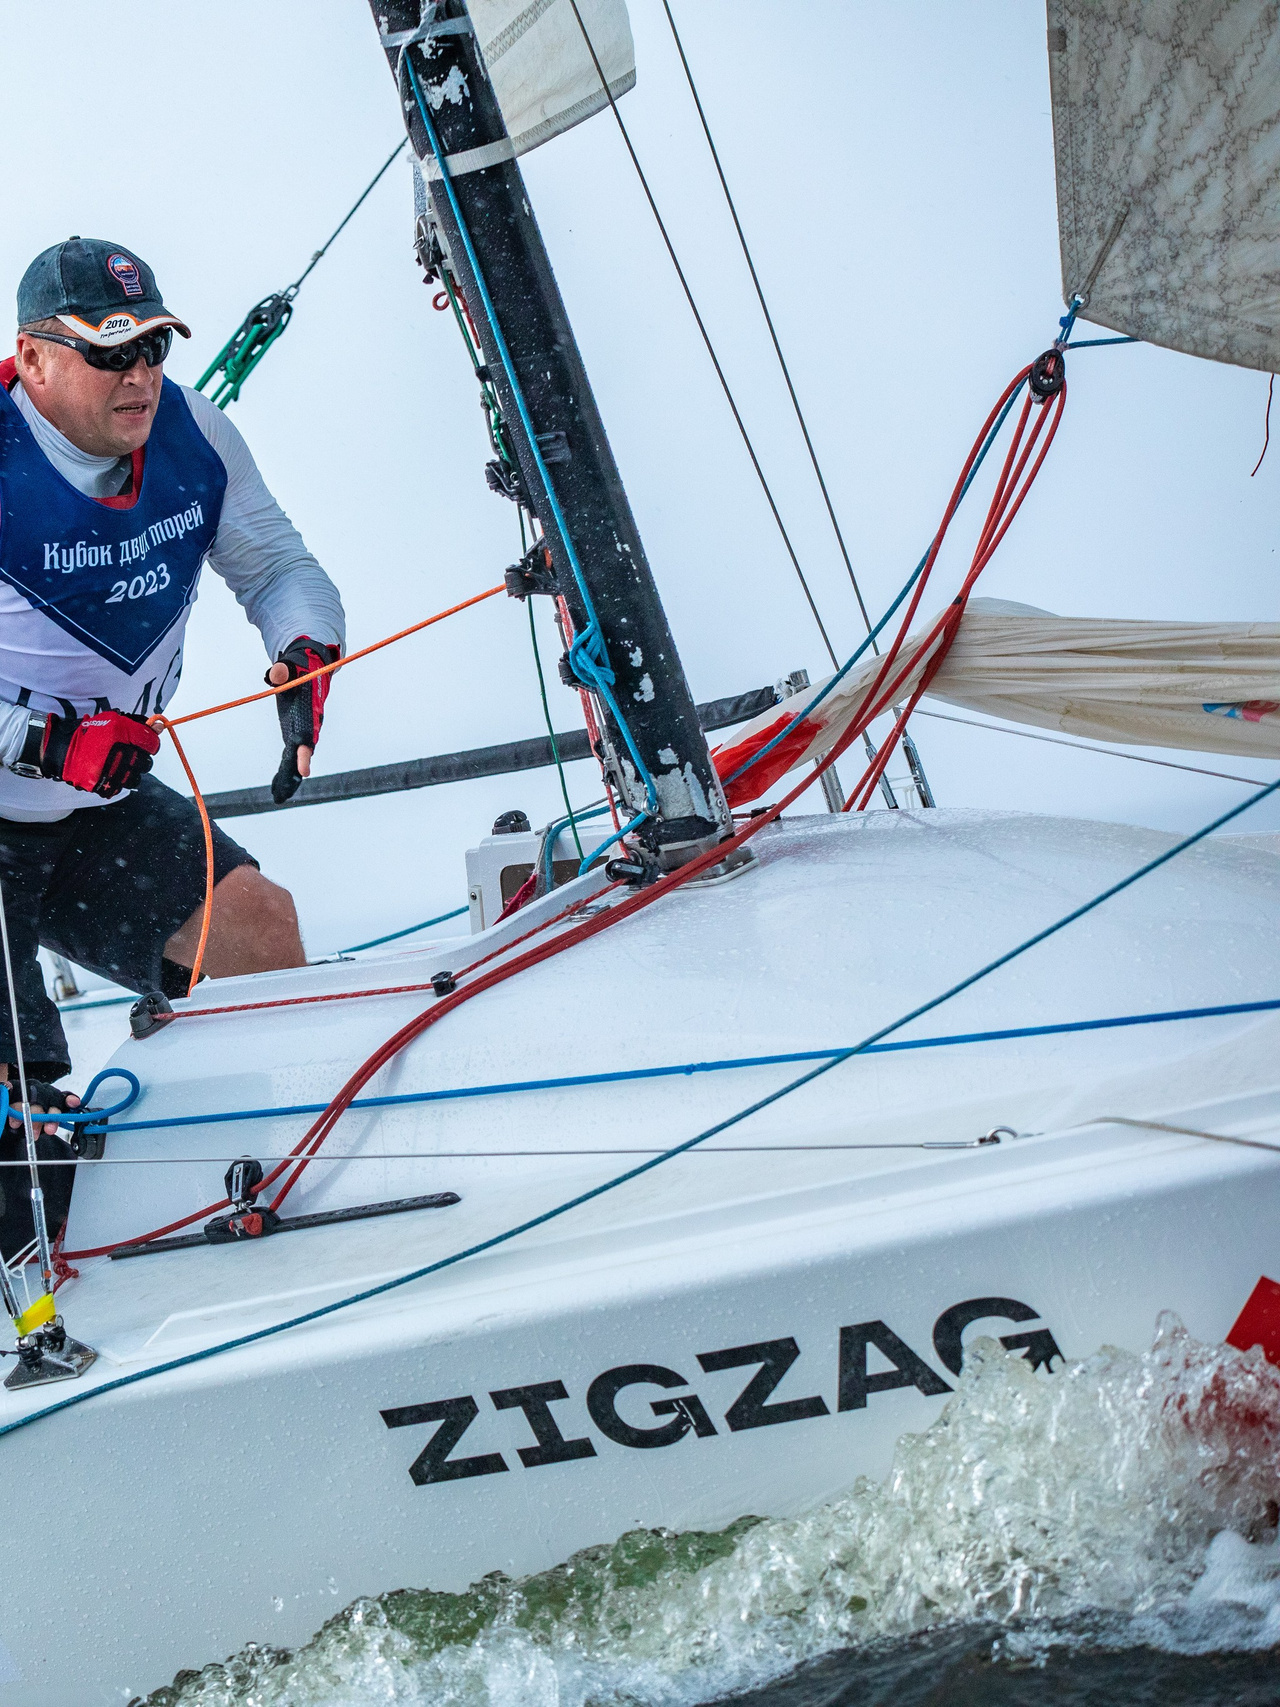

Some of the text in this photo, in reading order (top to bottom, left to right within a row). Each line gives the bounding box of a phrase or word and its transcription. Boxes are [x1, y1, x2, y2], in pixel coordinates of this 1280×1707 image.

[105, 319, 130, 330] 2010
[43, 542, 113, 574] Кубок
[118, 530, 151, 567] двух
[105, 563, 171, 604] 2023
[378, 1296, 1066, 1487] ZIGZAG
